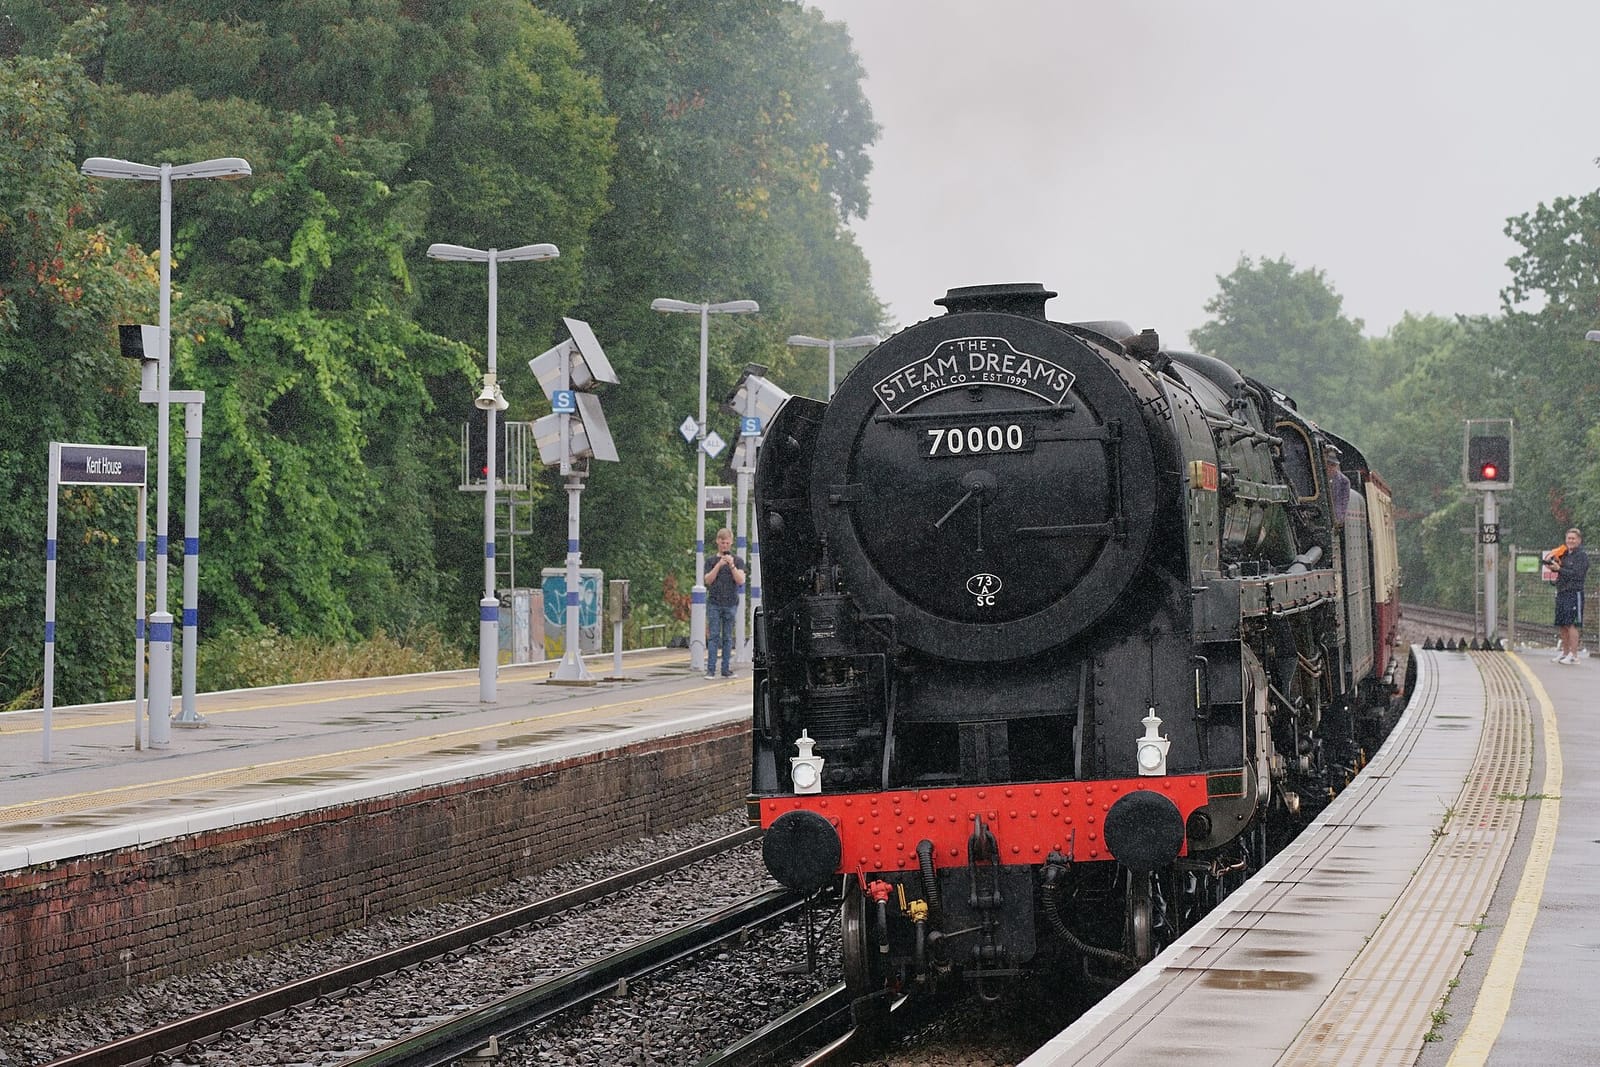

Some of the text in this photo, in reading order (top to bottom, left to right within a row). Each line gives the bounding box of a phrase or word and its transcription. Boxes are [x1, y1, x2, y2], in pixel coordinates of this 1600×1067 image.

[957, 340, 988, 352] THE
[880, 352, 1068, 401] STEAM DREAMS
[921, 372, 1027, 393] RAIL CO EST 1999
[558, 392, 570, 408] S
[746, 418, 757, 432] S
[927, 424, 1023, 455] 70000
[86, 455, 122, 475] Kent House
[976, 575, 992, 587] 73
[981, 585, 989, 595] A
[976, 595, 995, 607] SC
